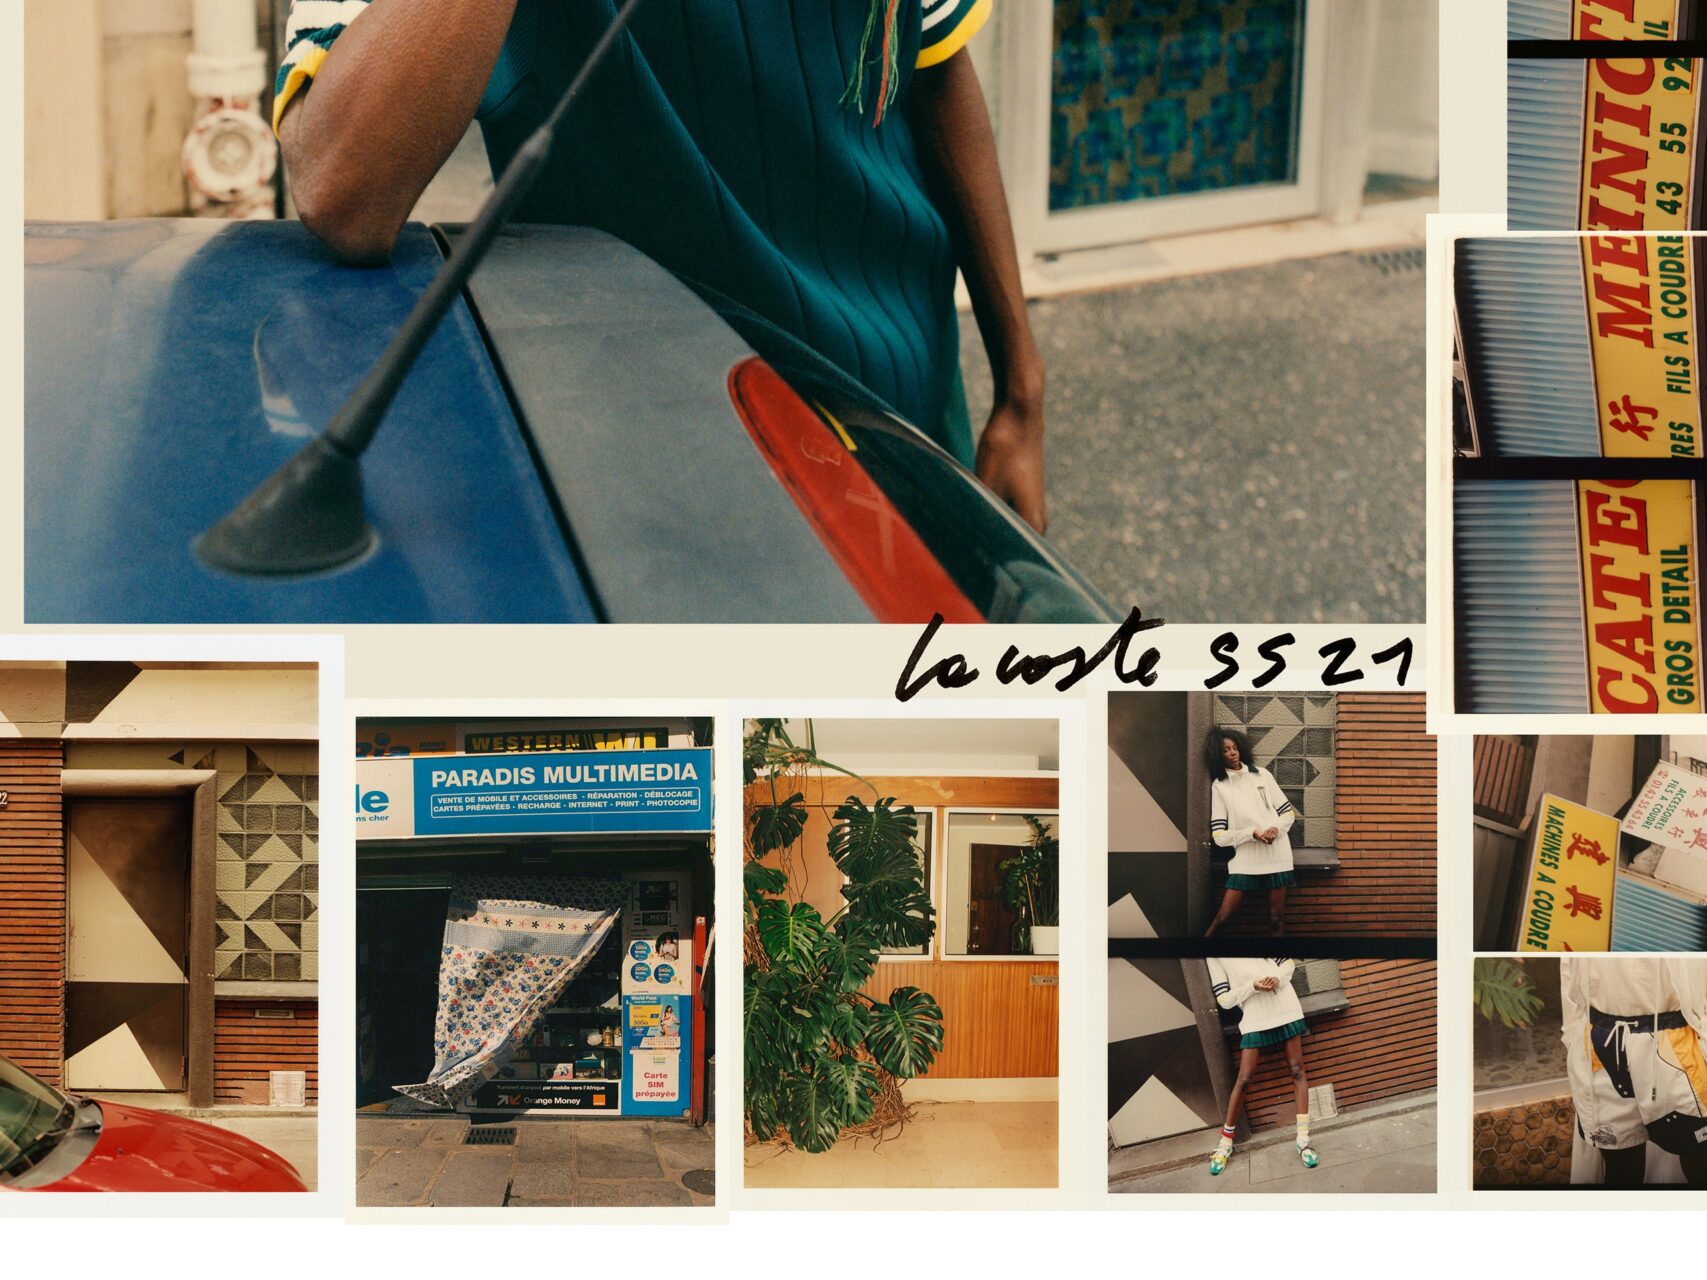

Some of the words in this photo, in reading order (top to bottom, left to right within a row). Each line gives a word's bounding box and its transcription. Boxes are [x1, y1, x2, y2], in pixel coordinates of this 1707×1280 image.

[1662, 58, 1692, 91] 92
[1659, 122, 1687, 154] 55
[1656, 181, 1684, 215] 43
[1657, 236, 1688, 319] COUDRE
[1663, 331, 1689, 345] A
[1664, 355, 1691, 395] FILS
[1586, 480, 1659, 714] CATE
[1660, 544, 1691, 624] DETAIL
[1664, 639, 1695, 705] GROS
[471, 733, 580, 751] WESTERN
[432, 766, 536, 788] PARADIS
[543, 762, 698, 784] MULTIMEDIA
[1664, 779, 1680, 794] FILS
[433, 804, 464, 813] CARTES
[465, 802, 511, 811] PRÉPAYÉES
[517, 802, 561, 810] RECHARGE
[615, 800, 639, 808] PRINT
[646, 799, 698, 807] PHOTOCOPIE
[437, 796, 463, 804] VENTE
[465, 795, 476, 803] DE
[478, 795, 508, 803] MOBILE
[509, 794, 520, 802] ET
[522, 793, 578, 801] ACCESSOIRES
[587, 791, 637, 800] RÉPARATION
[644, 790, 693, 798] DÉBLOCAGE
[1654, 788, 1687, 831] ACCESSOIRES
[368, 814, 390, 822] cher
[1641, 803, 1664, 830] COUDRE
[1540, 804, 1566, 870] MACHINES
[1536, 871, 1557, 884] A
[1526, 889, 1555, 951] COUDRE
[523, 1097, 553, 1106] Orange
[554, 1097, 581, 1106] Money
[635, 1090, 676, 1098] prépayée
